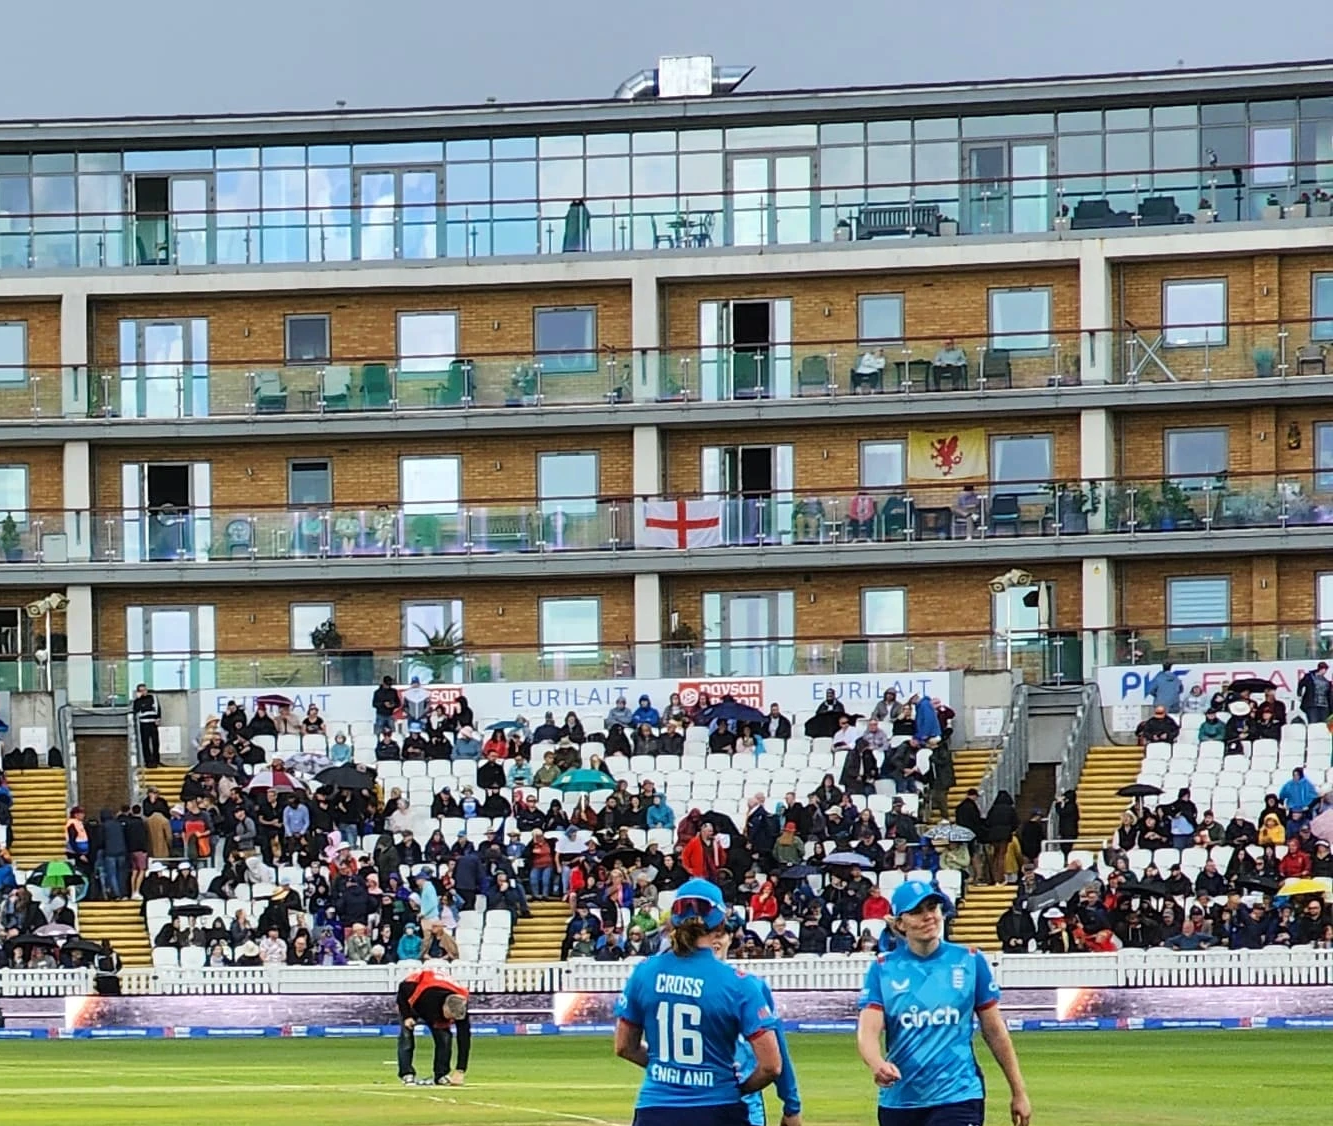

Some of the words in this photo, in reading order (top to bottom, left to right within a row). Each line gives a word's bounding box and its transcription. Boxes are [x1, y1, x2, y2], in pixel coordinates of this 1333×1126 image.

[512, 687, 629, 707] EURILAIT
[655, 972, 705, 998] CROSS
[900, 1005, 960, 1030] cinch
[656, 1001, 704, 1065] 16
